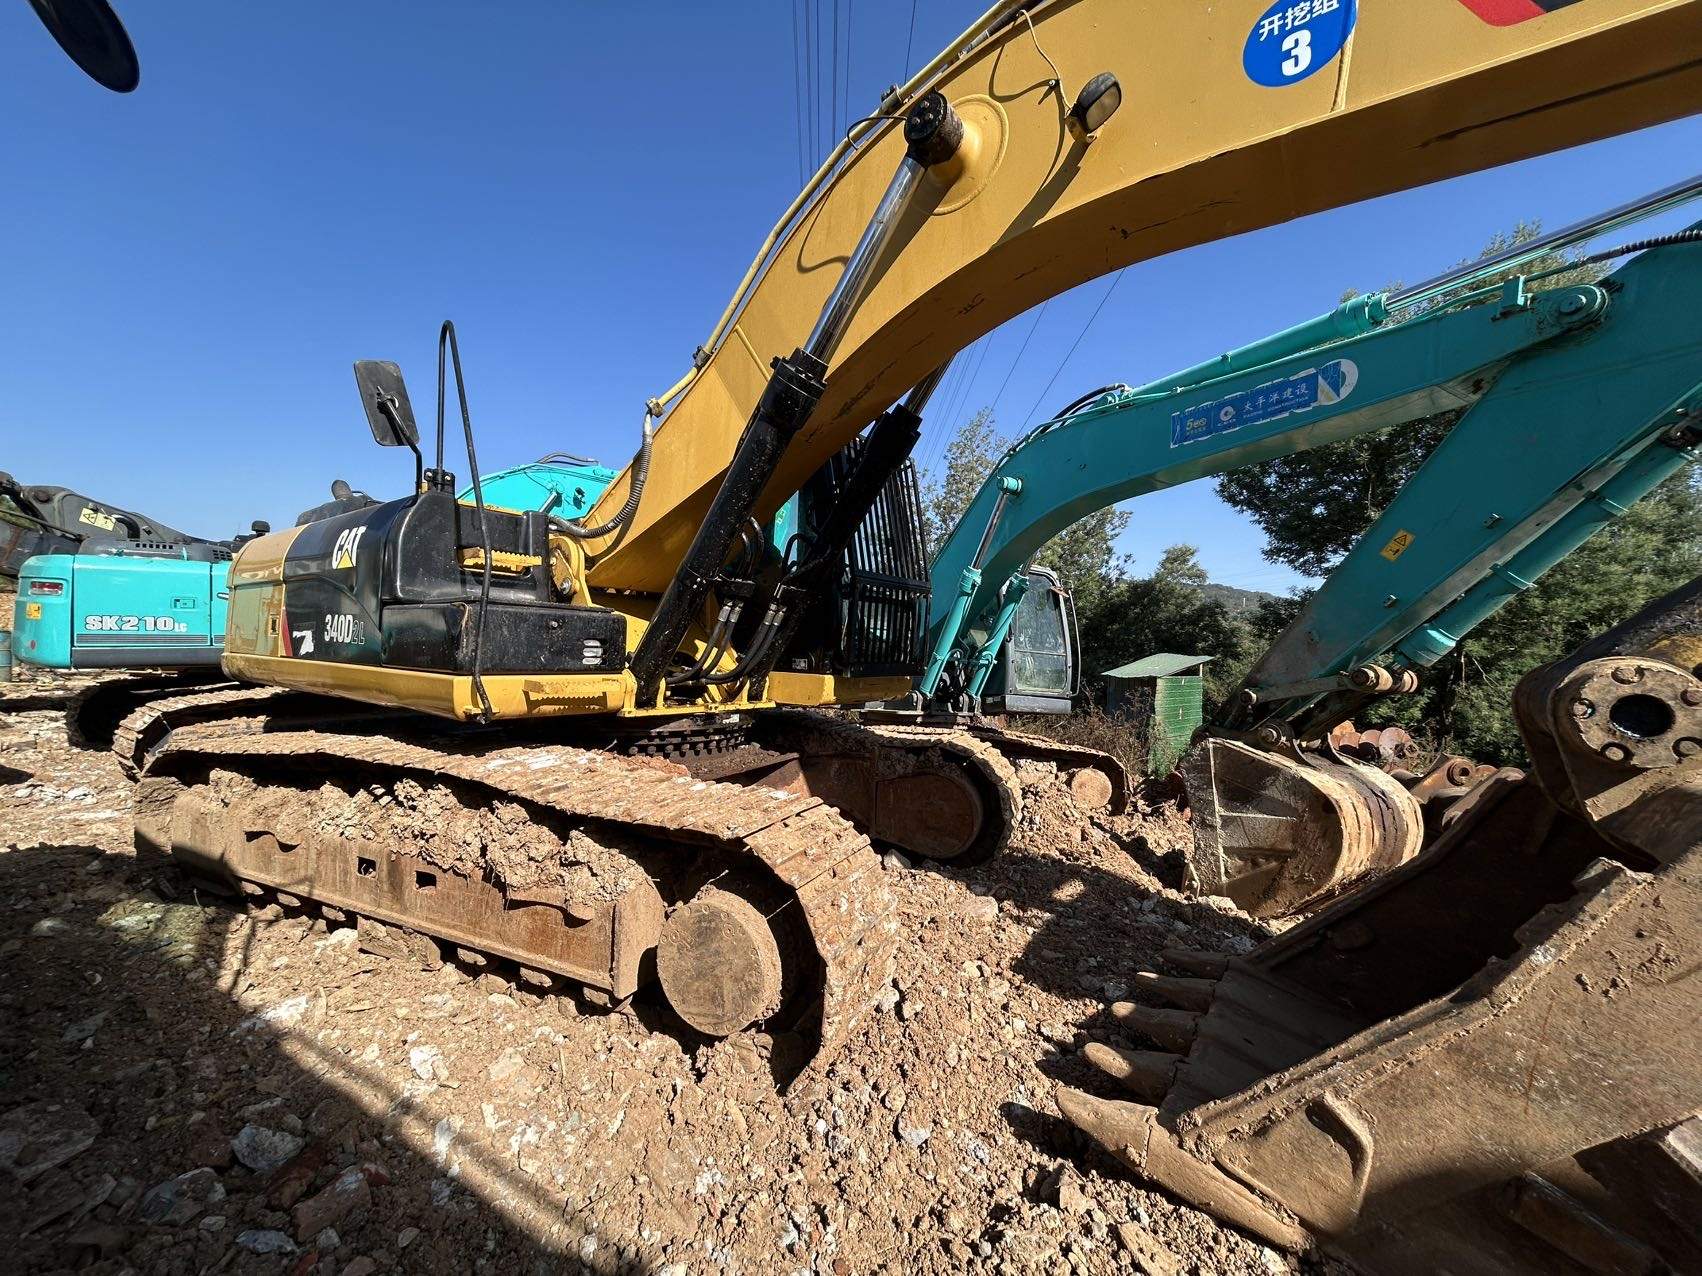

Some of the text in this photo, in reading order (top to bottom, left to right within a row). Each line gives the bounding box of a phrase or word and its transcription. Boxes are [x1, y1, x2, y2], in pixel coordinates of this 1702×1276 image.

[1259, 0, 1339, 41] 开挖组
[1282, 29, 1312, 76] 3
[332, 526, 368, 569] CAT
